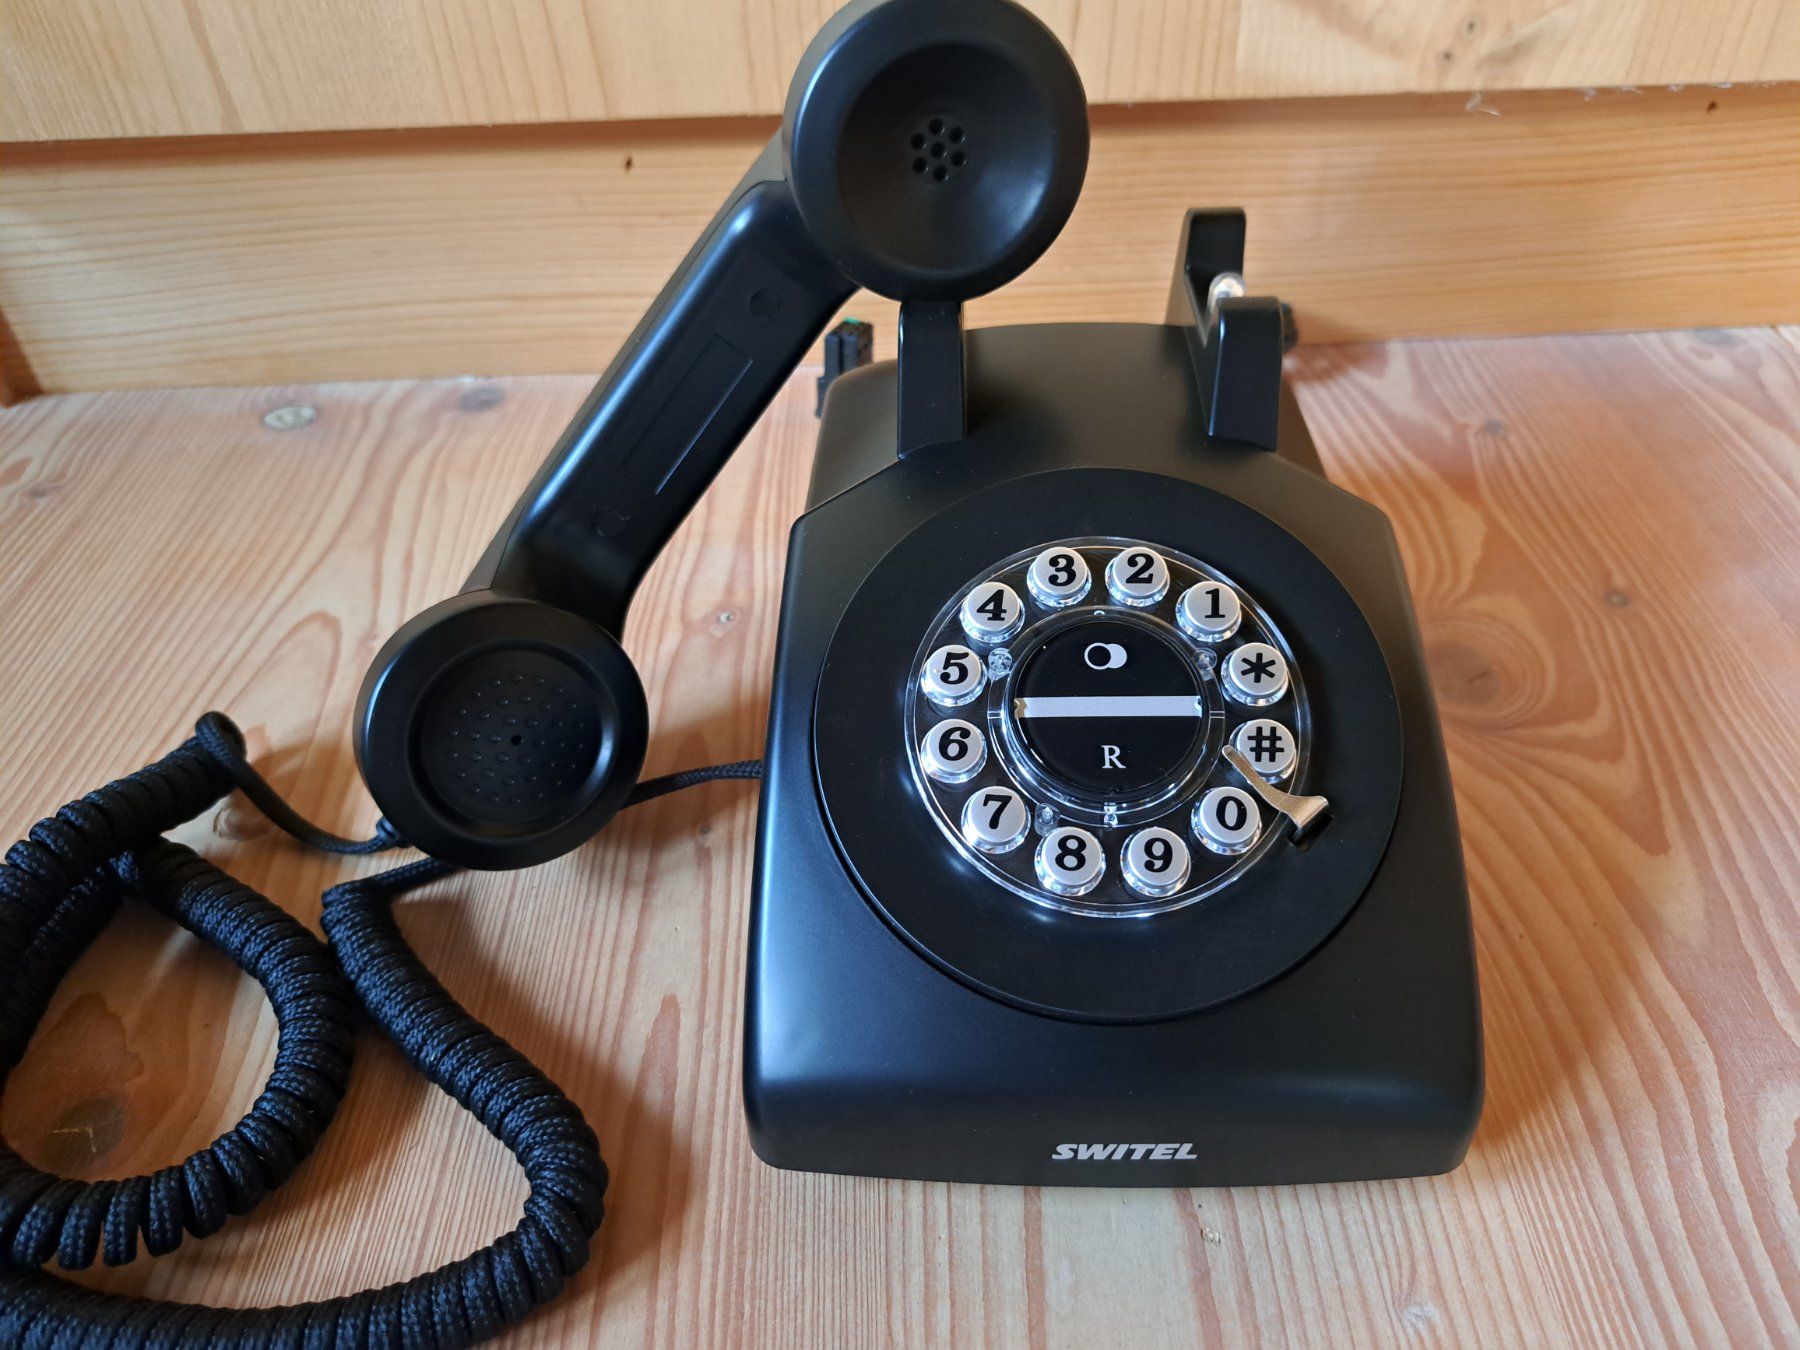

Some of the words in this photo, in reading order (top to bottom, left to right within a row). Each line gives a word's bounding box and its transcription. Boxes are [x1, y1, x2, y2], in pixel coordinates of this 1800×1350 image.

[1048, 554, 1077, 587] 3
[1125, 553, 1155, 584] 2
[976, 589, 1007, 621] 4
[1204, 588, 1227, 619] 1
[939, 652, 970, 685] 5
[938, 727, 971, 761] 6
[1101, 745, 1126, 769] R
[1247, 726, 1284, 763] #
[982, 795, 1013, 830] 7
[1216, 795, 1248, 831] 0
[1054, 835, 1087, 871] 8
[1143, 837, 1173, 873] 9
[1052, 1143, 1197, 1160] SWITEL
